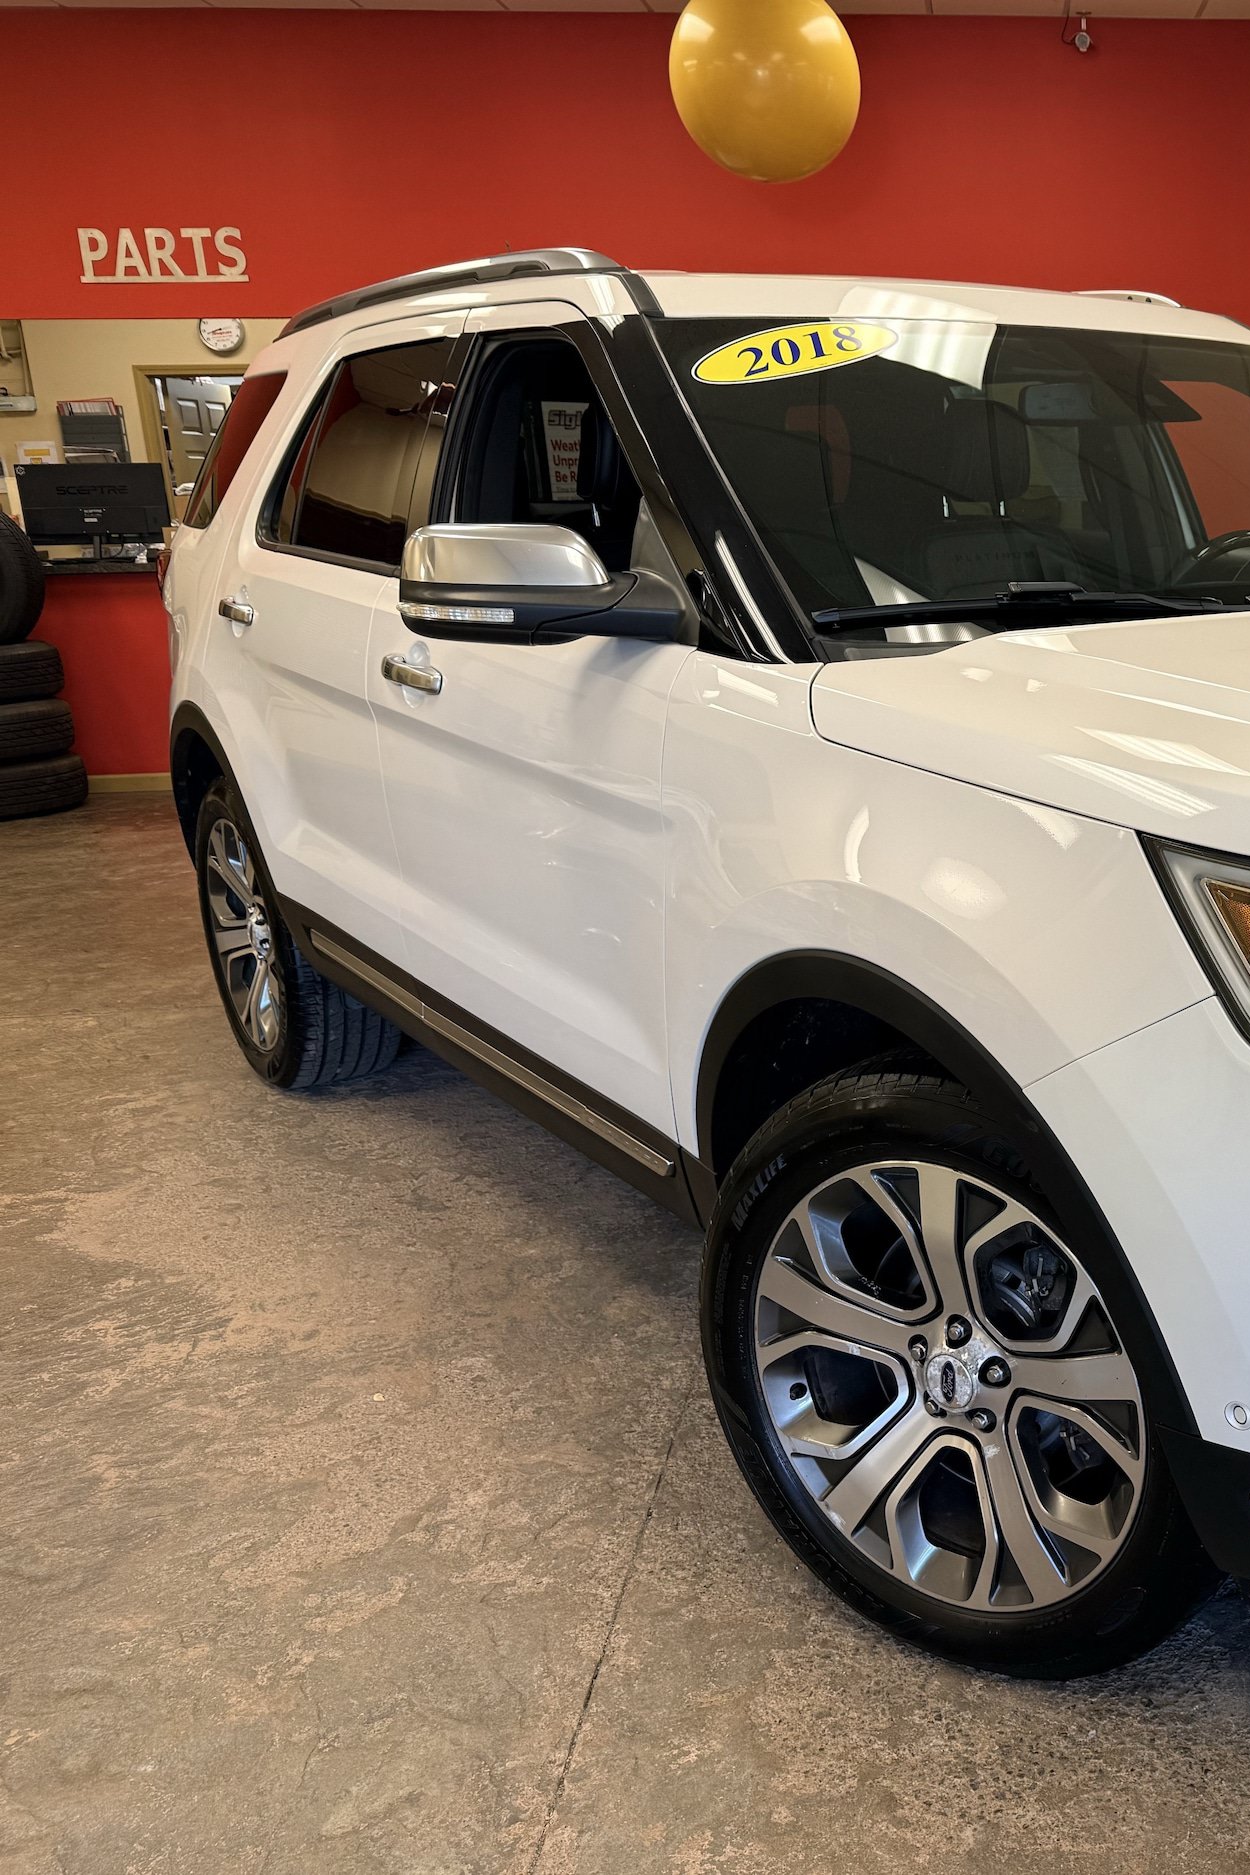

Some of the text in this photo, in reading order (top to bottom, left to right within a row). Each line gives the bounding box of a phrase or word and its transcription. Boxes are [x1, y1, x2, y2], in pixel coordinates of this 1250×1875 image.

[77, 226, 249, 282] PARTS
[737, 326, 862, 377] 2018
[551, 439, 581, 452] Weat
[553, 454, 578, 469] Unpr
[555, 471, 577, 482] Be R
[56, 485, 128, 495] SCEPTRE
[730, 1153, 787, 1231] MAXLIFE
[942, 1368, 953, 1397] Ford
